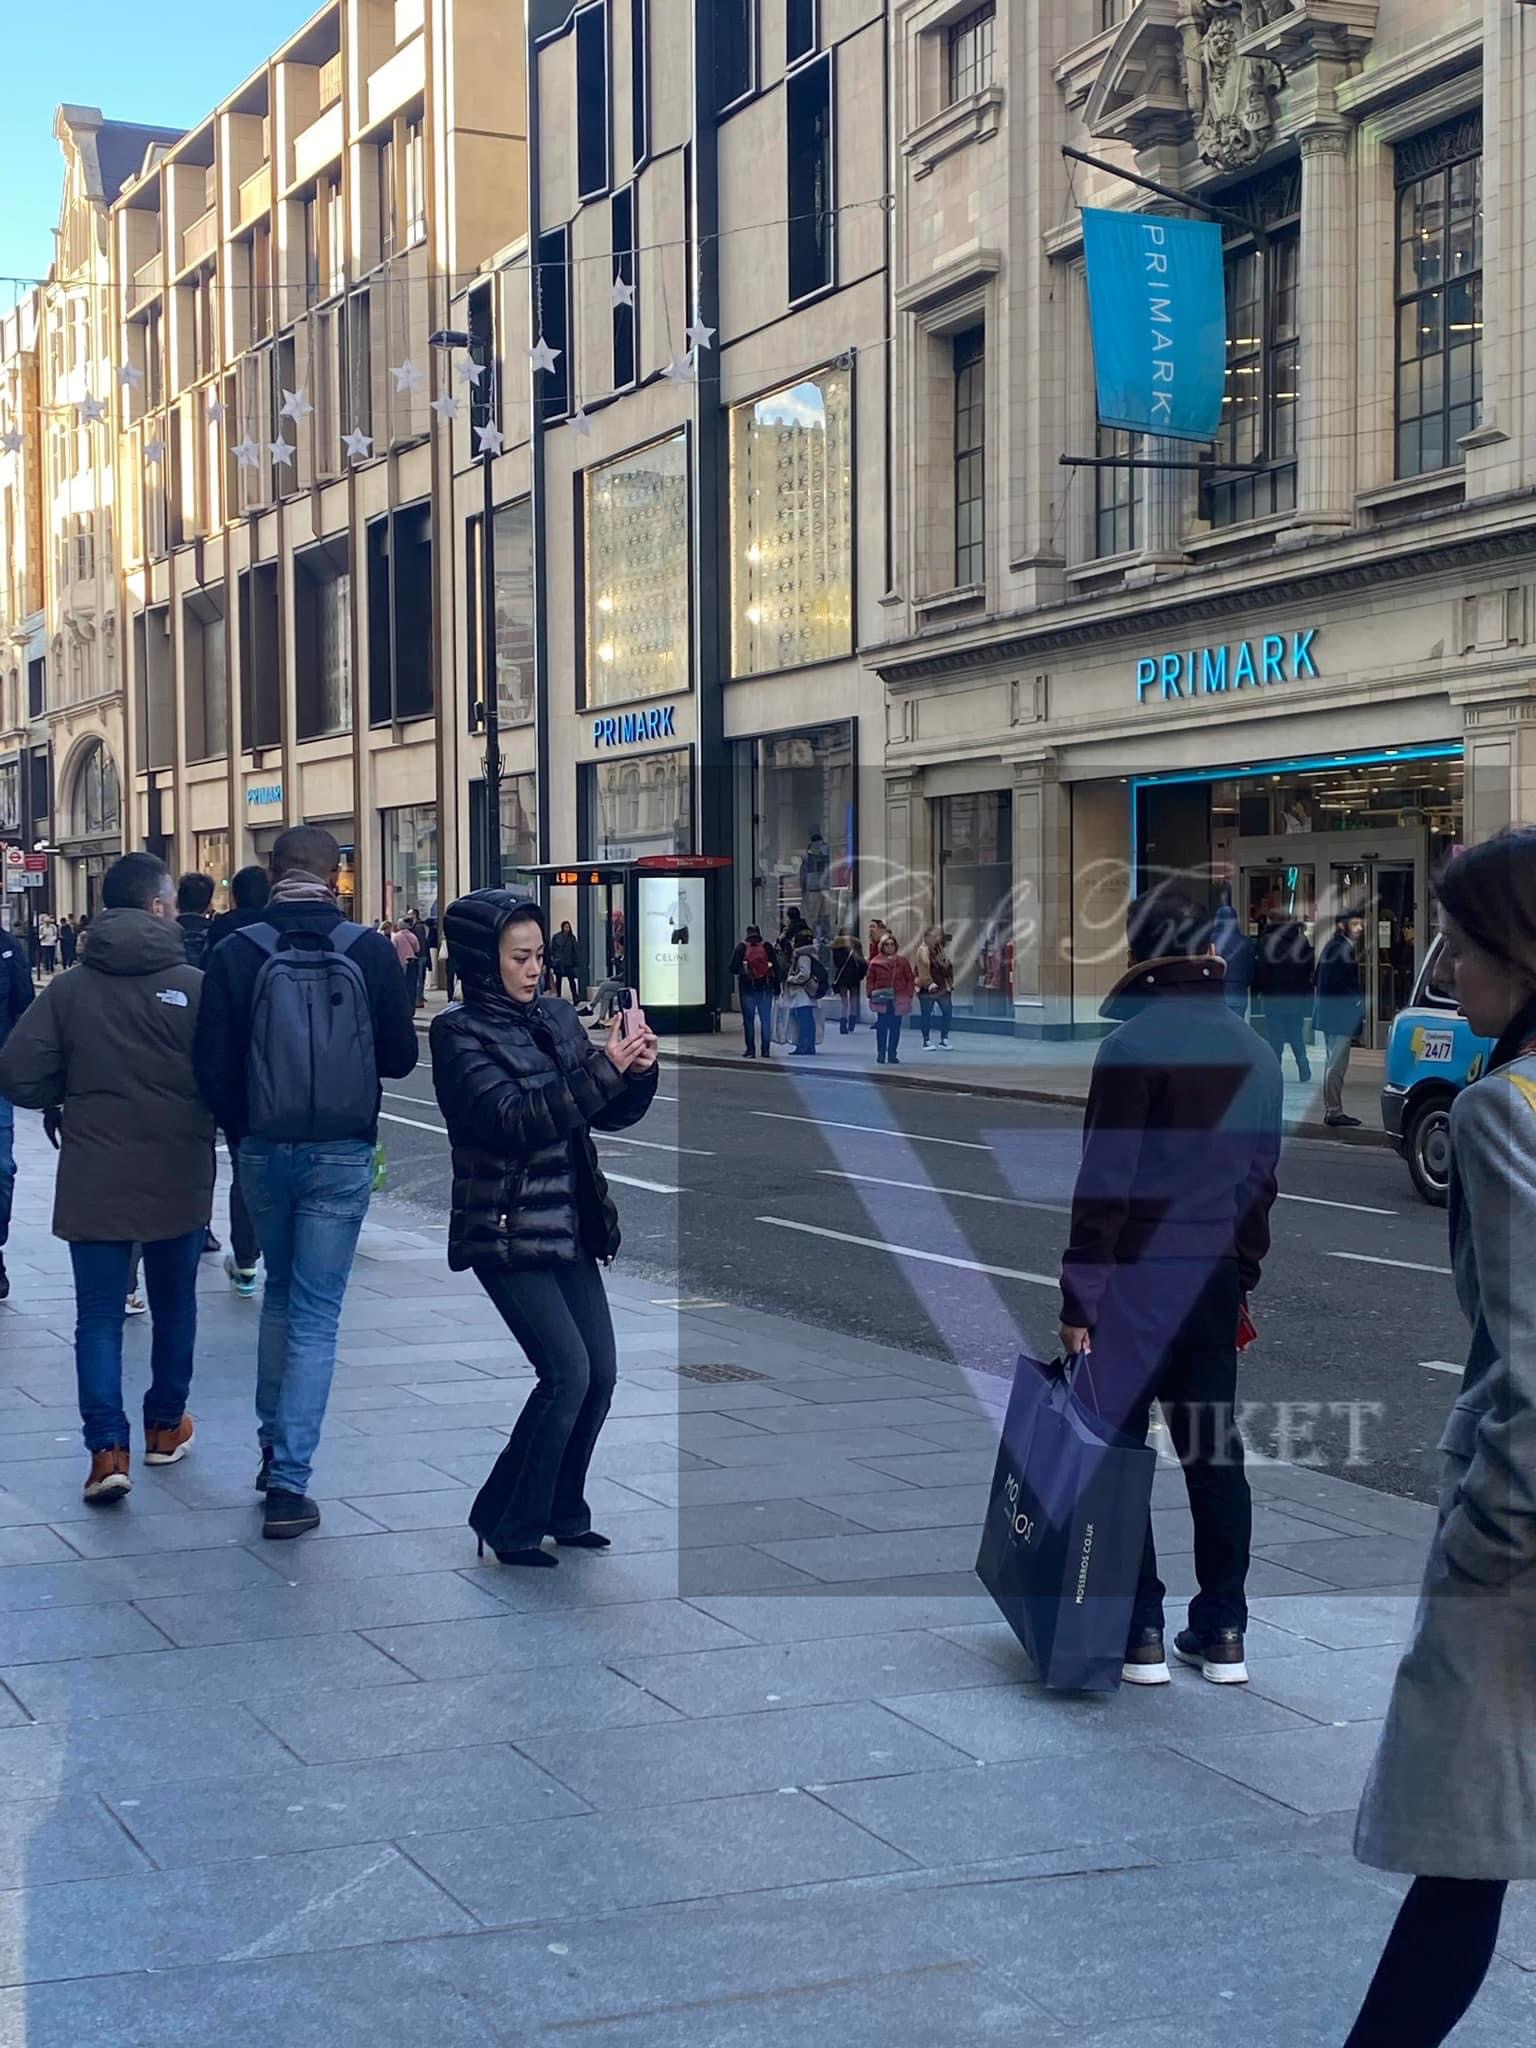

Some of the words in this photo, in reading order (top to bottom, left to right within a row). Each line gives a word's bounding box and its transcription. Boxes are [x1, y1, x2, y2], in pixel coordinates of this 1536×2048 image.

[1142, 223, 1175, 418] PRIMARK
[1136, 628, 1320, 704] PRIMARK
[593, 705, 675, 749] PRIMARK
[247, 784, 282, 806] PRIMAR
[655, 952, 689, 962] CELINE
[1425, 1042, 1451, 1059] 24/7
